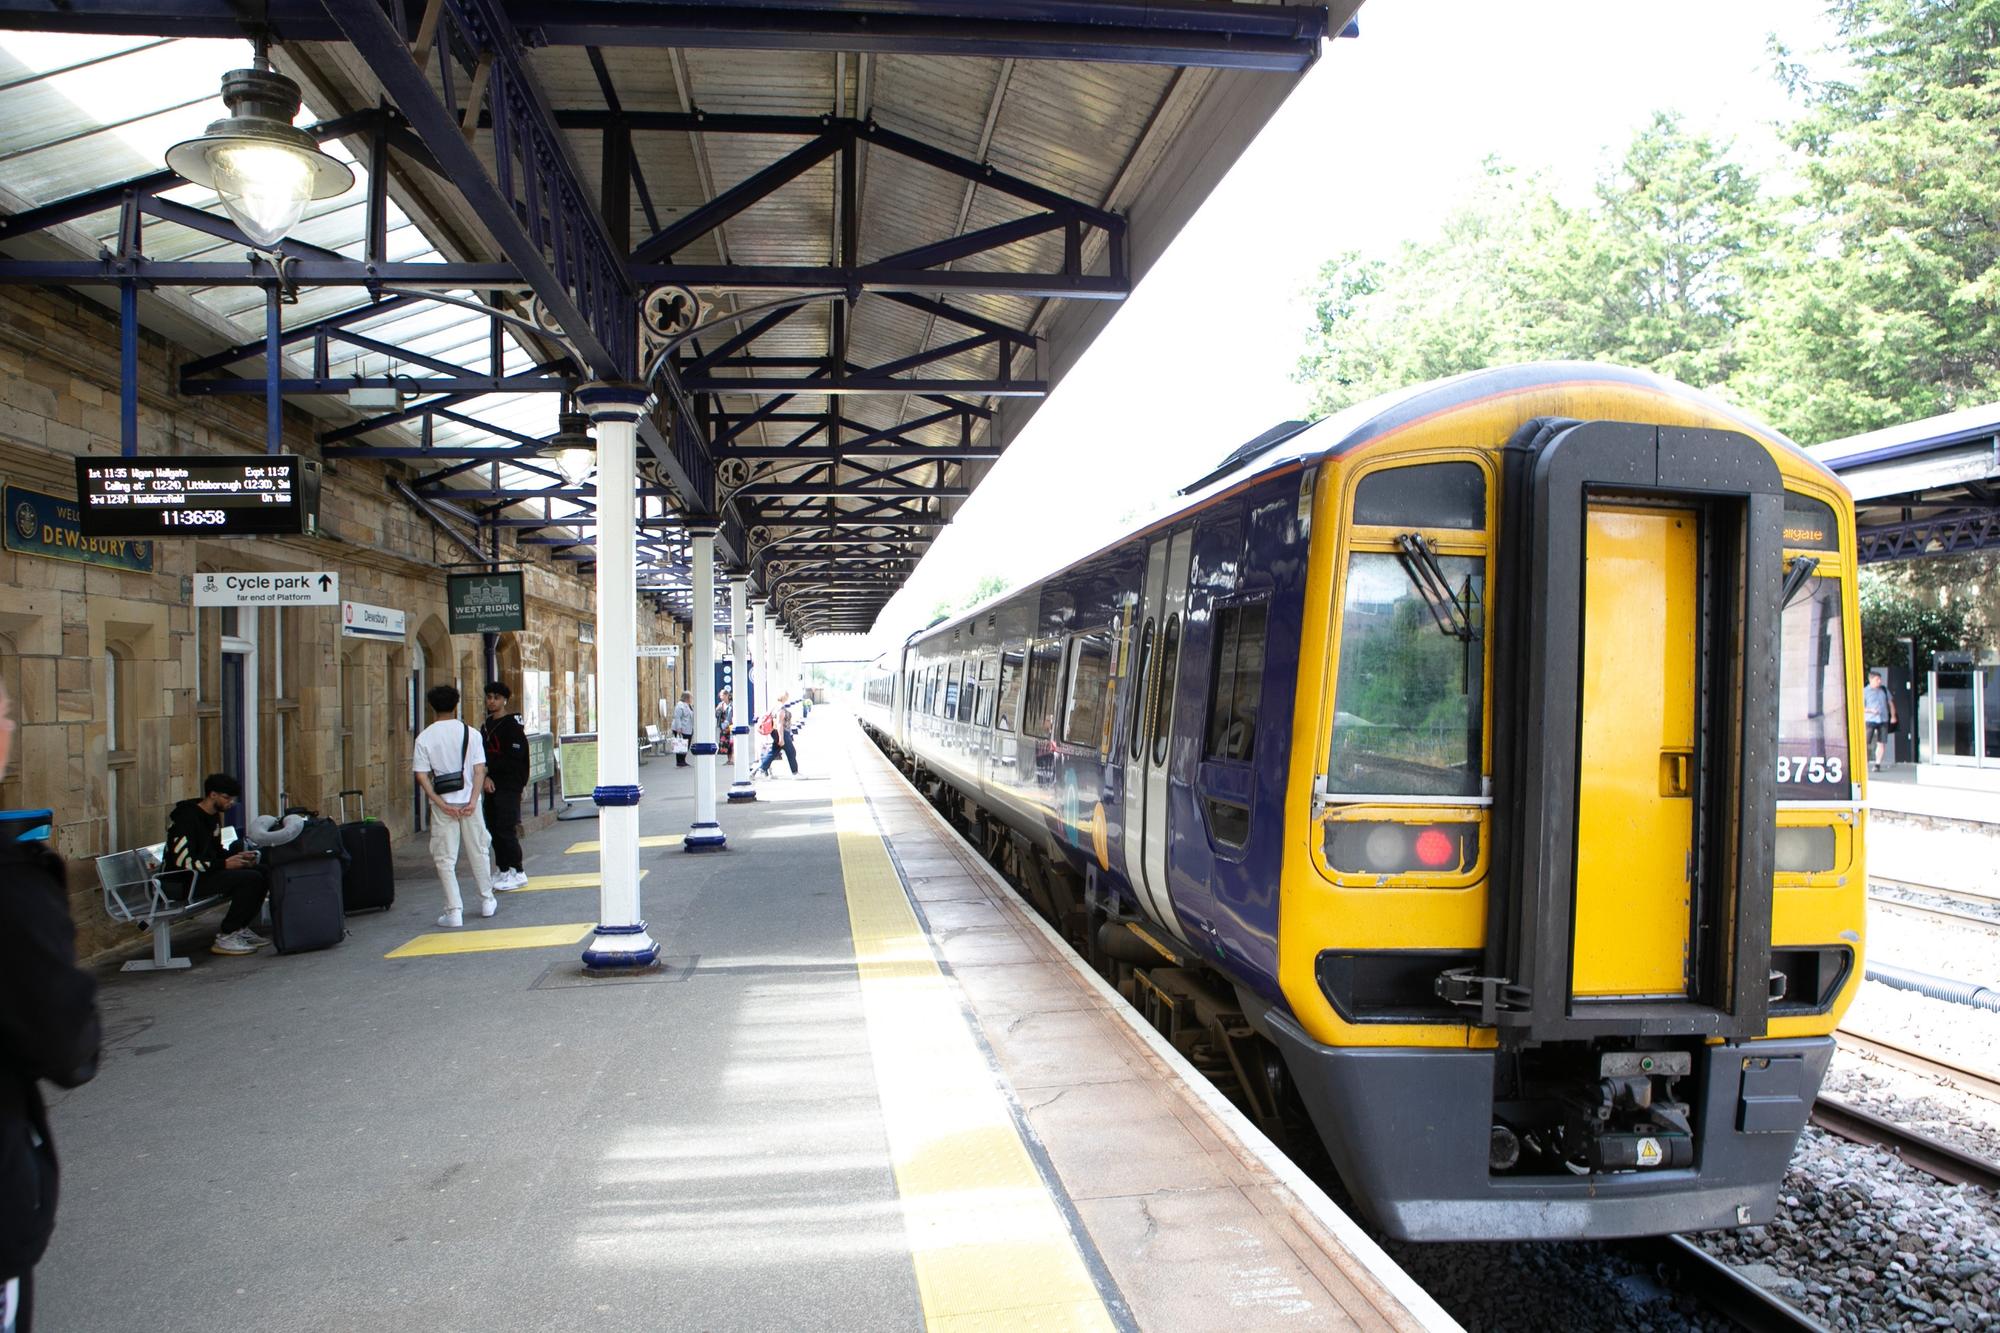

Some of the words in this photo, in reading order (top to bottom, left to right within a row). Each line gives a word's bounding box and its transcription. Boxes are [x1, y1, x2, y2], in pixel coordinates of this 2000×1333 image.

[88, 468, 101, 478] 1st
[104, 468, 127, 478] 11:35
[131, 468, 154, 480] Wigan
[156, 467, 189, 480] Wallgate
[244, 466, 264, 479] Expt
[267, 466, 290, 477] 11:37
[104, 480, 131, 493] Calling
[132, 481, 145, 491] at:
[186, 479, 241, 492] Littleborough
[90, 494, 105, 504] 3rd
[106, 493, 129, 504] 12:04
[133, 493, 185, 504] Huddersfield
[261, 492, 273, 502] On
[275, 492, 291, 502] time
[162, 510, 225, 525] 11:36:58
[43, 524, 126, 557] DEWSBURY
[226, 576, 270, 591] Cycle
[274, 575, 311, 591] park
[267, 593, 275, 601] of
[277, 593, 311, 601] Platform
[455, 605, 482, 614] WEST
[485, 603, 520, 613] RIDING
[364, 610, 388, 628] Dewsbury
